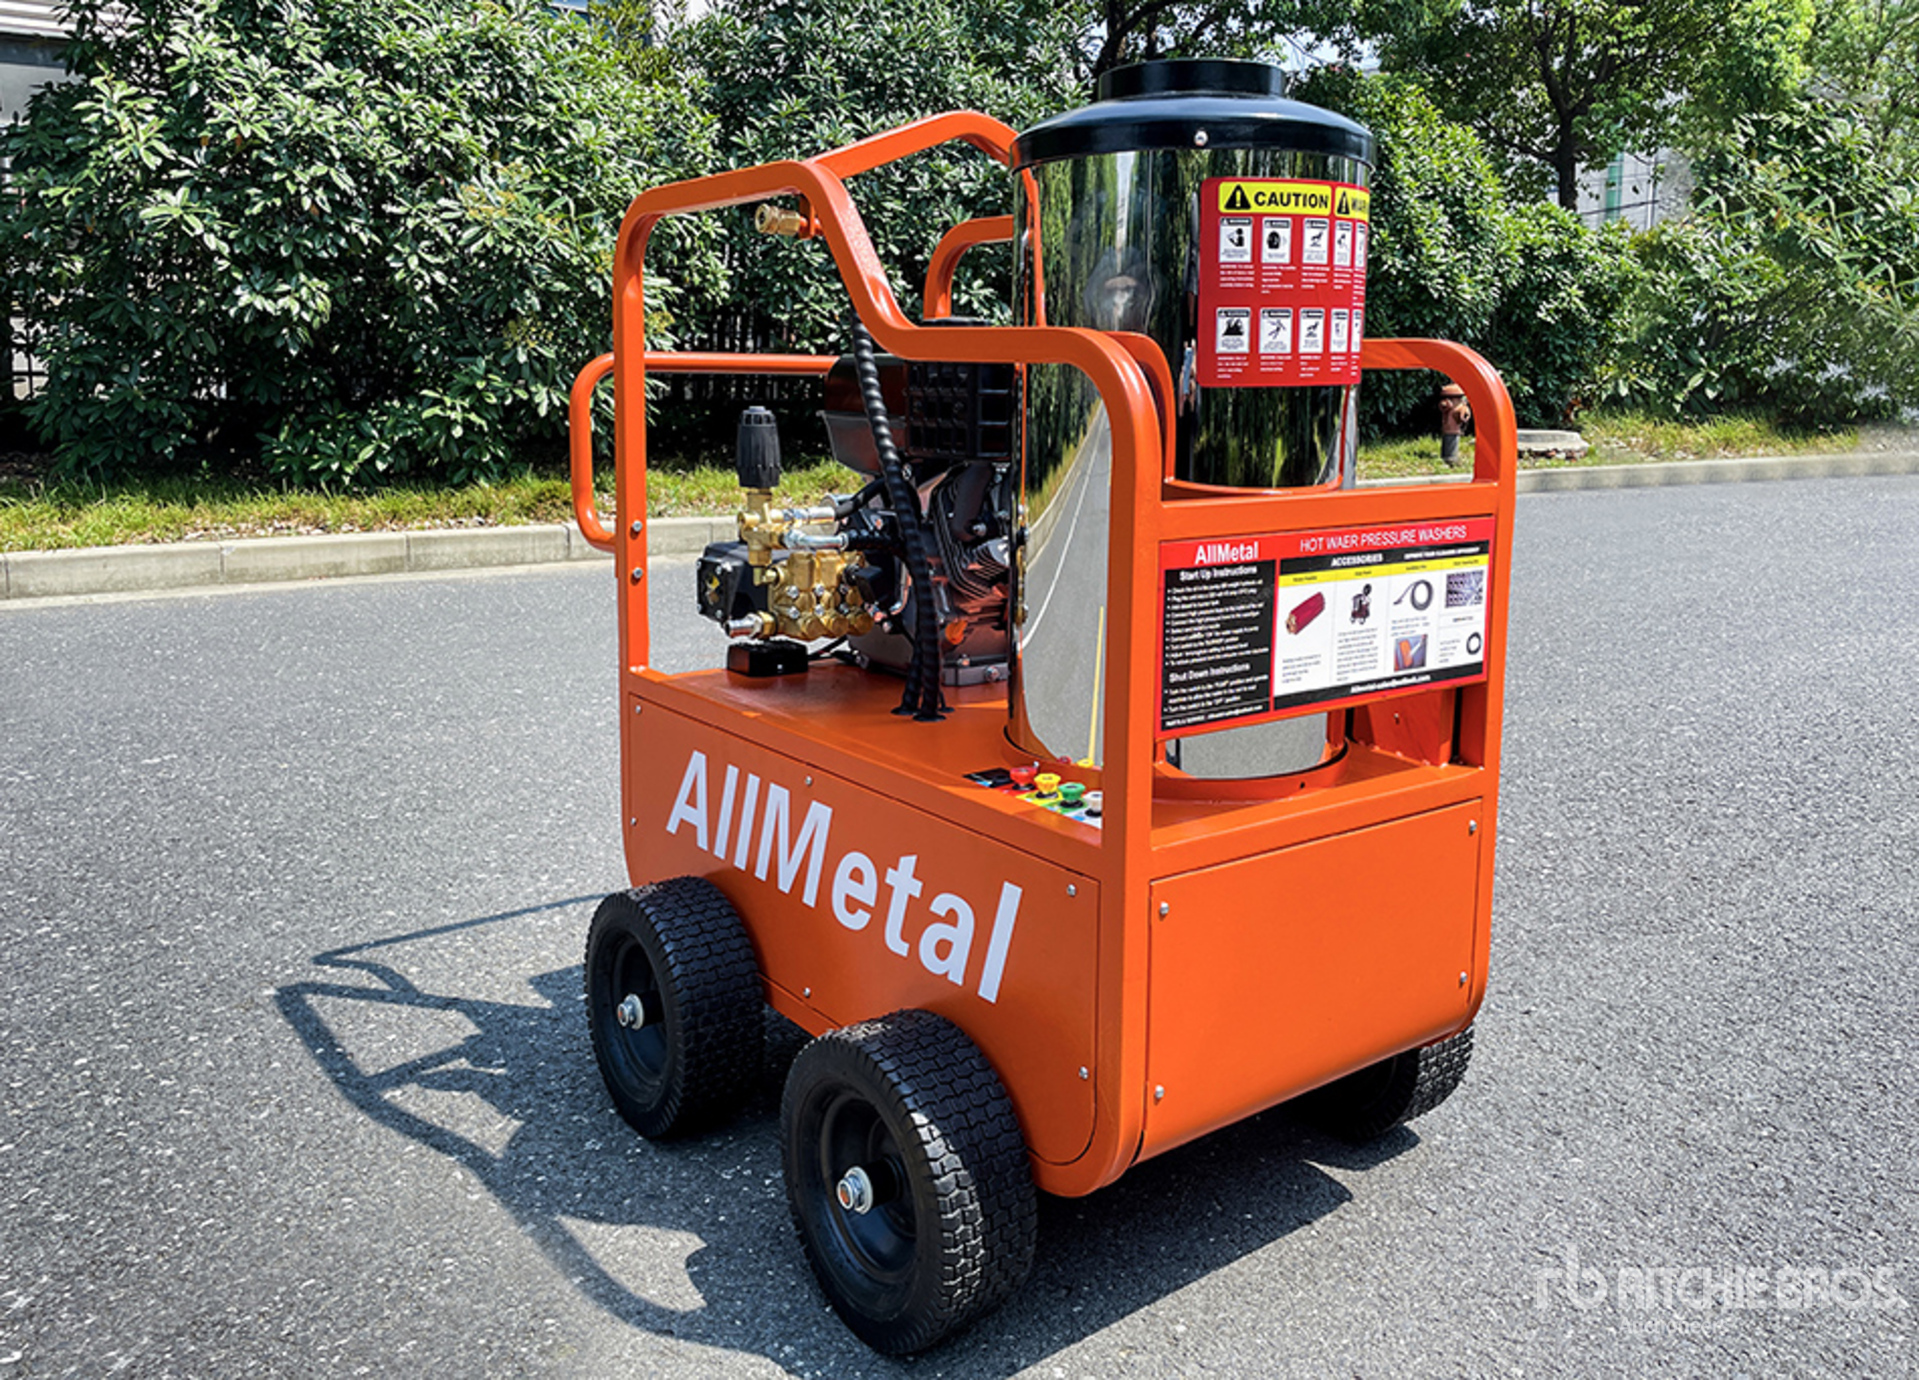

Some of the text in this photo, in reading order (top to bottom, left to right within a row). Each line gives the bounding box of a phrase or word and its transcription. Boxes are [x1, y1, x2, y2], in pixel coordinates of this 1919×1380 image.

[1254, 191, 1328, 209] CAUTION
[1300, 525, 1468, 553] HOT WAER PRESSURE WASHERS
[1194, 541, 1259, 566] AllMetal
[1331, 553, 1383, 567] ACCESSORIES
[1179, 570, 1199, 582] Start
[1213, 565, 1257, 578] Instructions
[1209, 662, 1251, 676] Instructions
[666, 750, 1023, 1004] AllMetal
